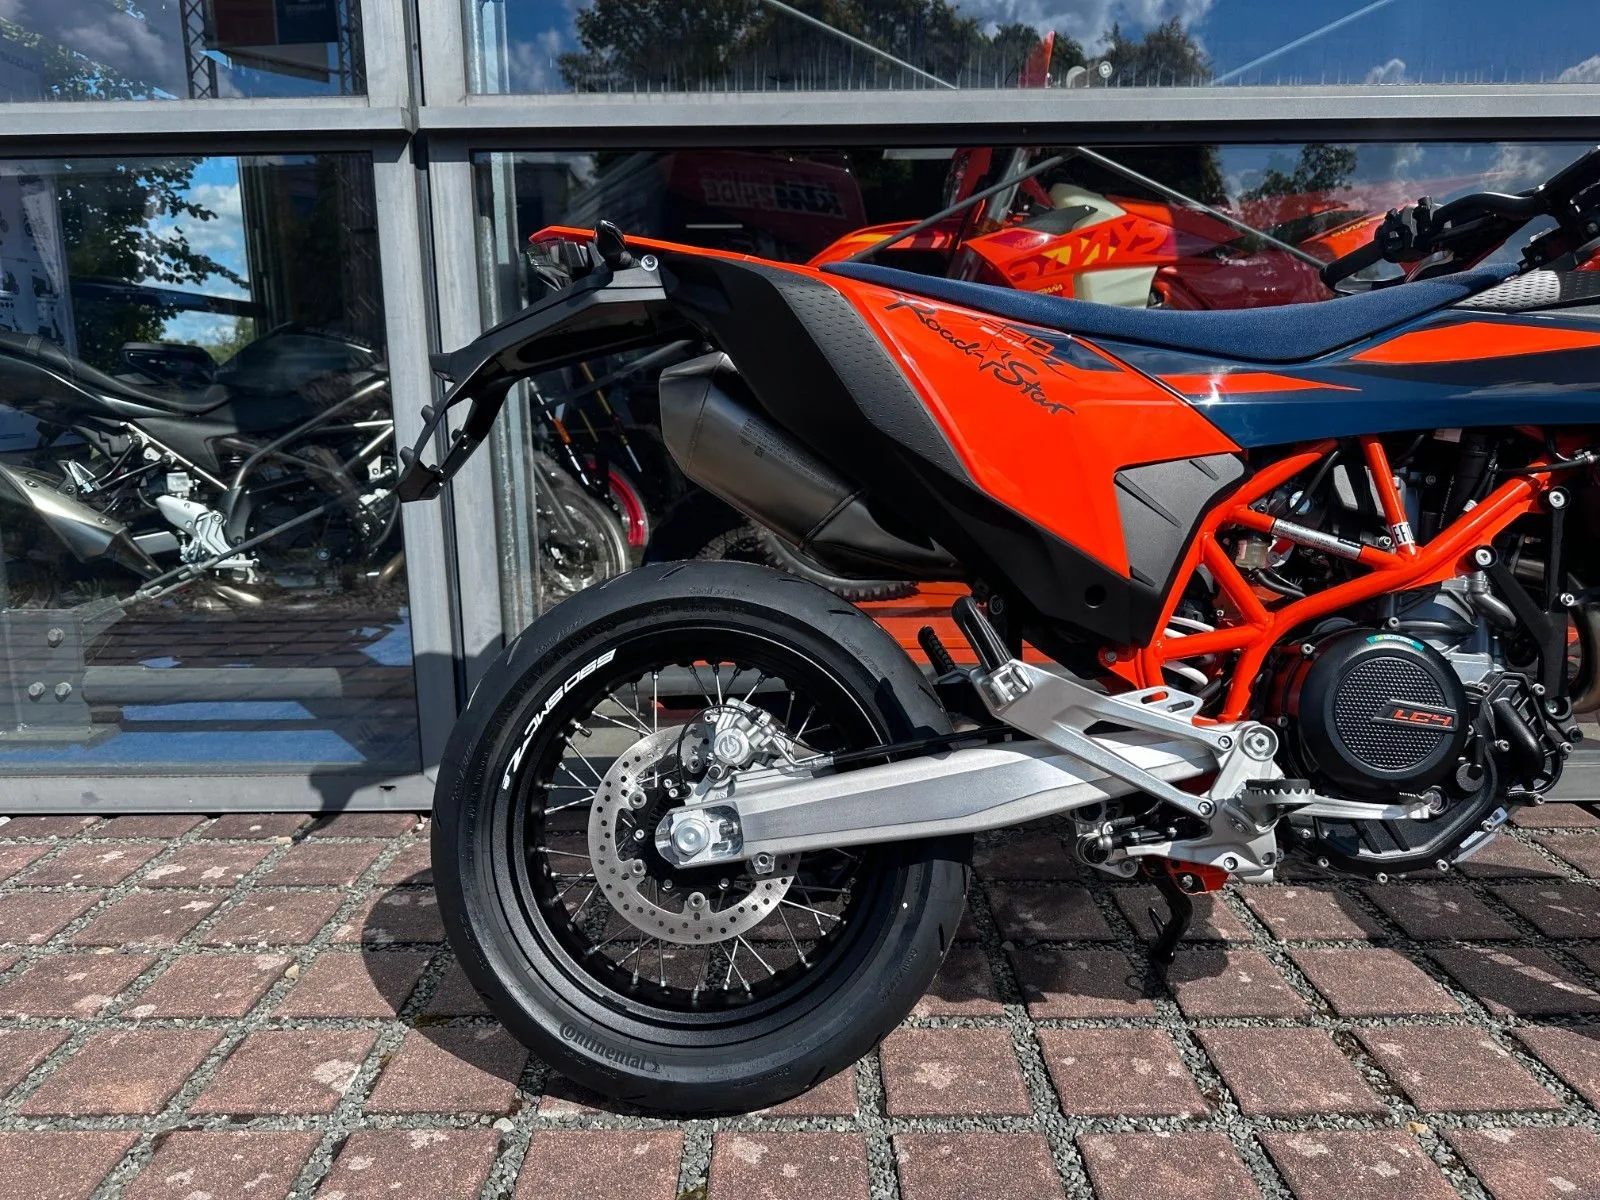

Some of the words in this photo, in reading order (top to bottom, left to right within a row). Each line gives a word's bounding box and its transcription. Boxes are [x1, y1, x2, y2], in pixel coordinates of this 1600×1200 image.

[884, 291, 981, 356] Road
[993, 360, 1076, 415] Star
[1393, 709, 1453, 727] LC4
[559, 1021, 648, 1071] Continental
